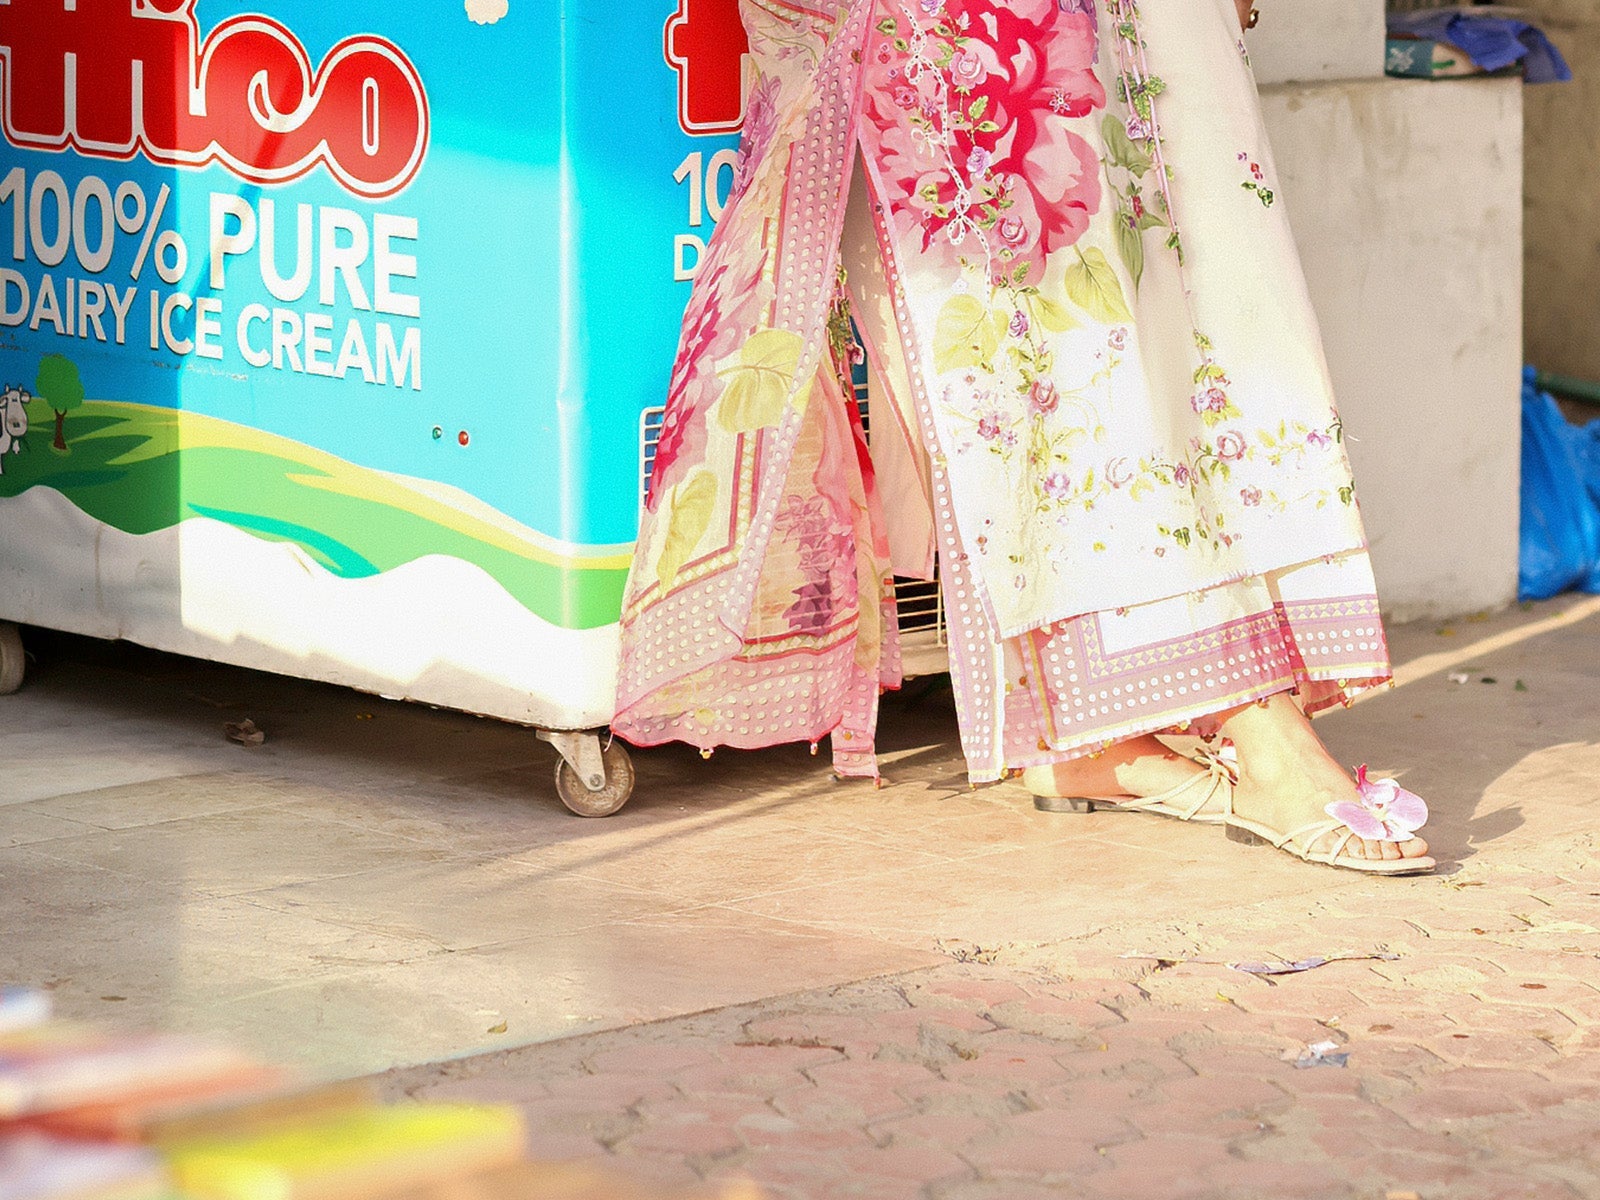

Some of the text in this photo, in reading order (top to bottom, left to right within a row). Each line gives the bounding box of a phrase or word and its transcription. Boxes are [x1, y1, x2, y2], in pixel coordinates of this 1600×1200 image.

[0, 167, 420, 318] 100% PURE
[0, 267, 423, 391] DAIRY ICE CREAM
